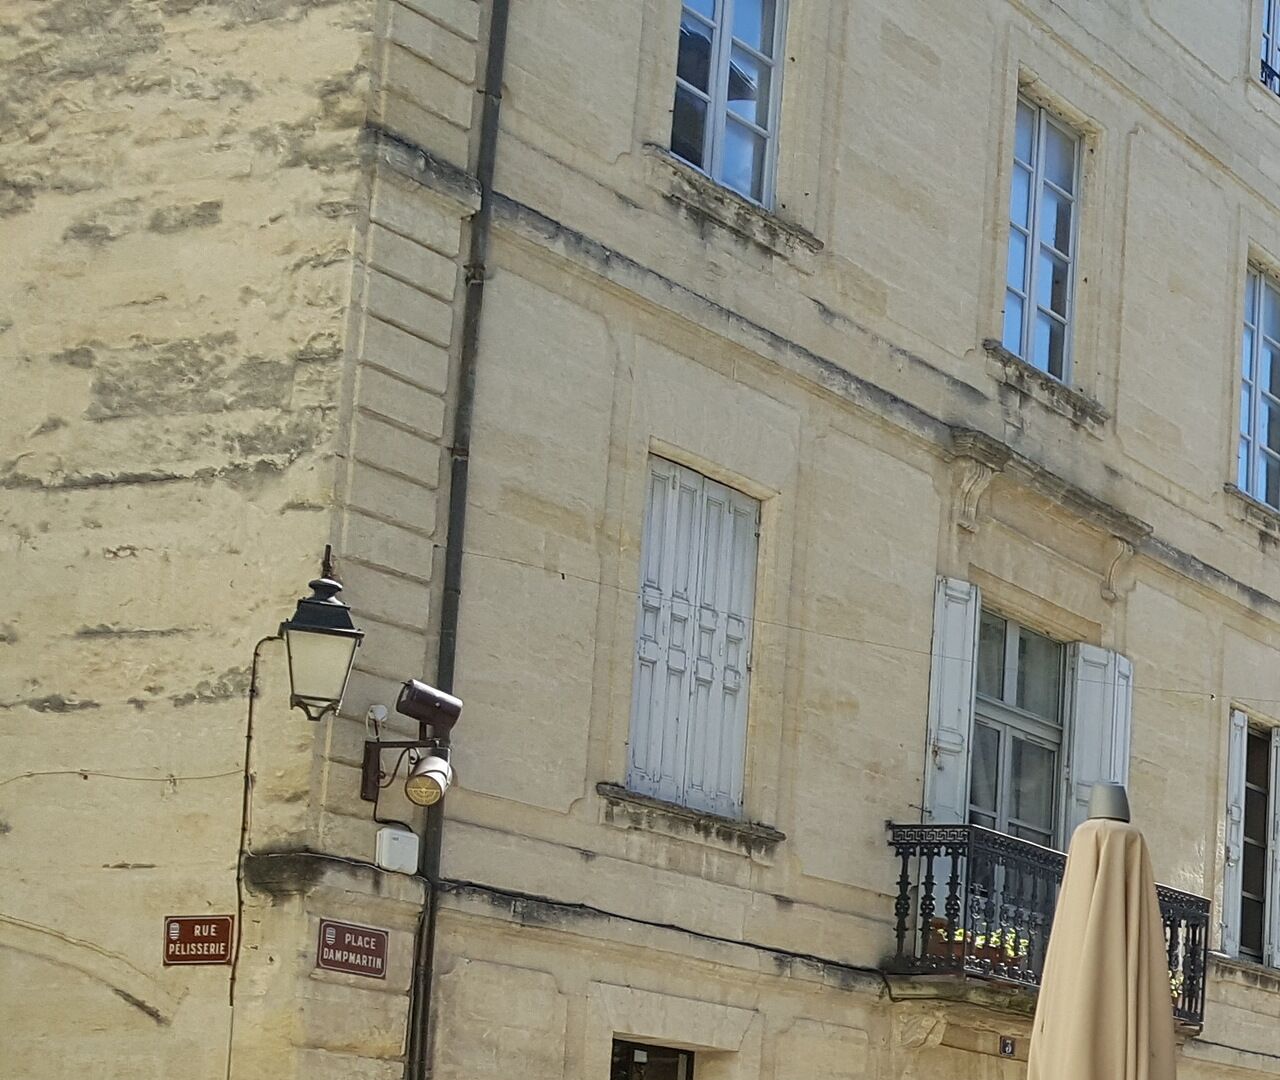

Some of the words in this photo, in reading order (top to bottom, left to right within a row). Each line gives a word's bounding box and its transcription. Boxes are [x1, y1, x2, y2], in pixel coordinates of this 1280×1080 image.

[194, 924, 217, 937] RUE
[169, 941, 226, 955] PÉLISSERIE
[345, 933, 376, 950] PLACE
[323, 948, 382, 969] DAMPMARTIN
